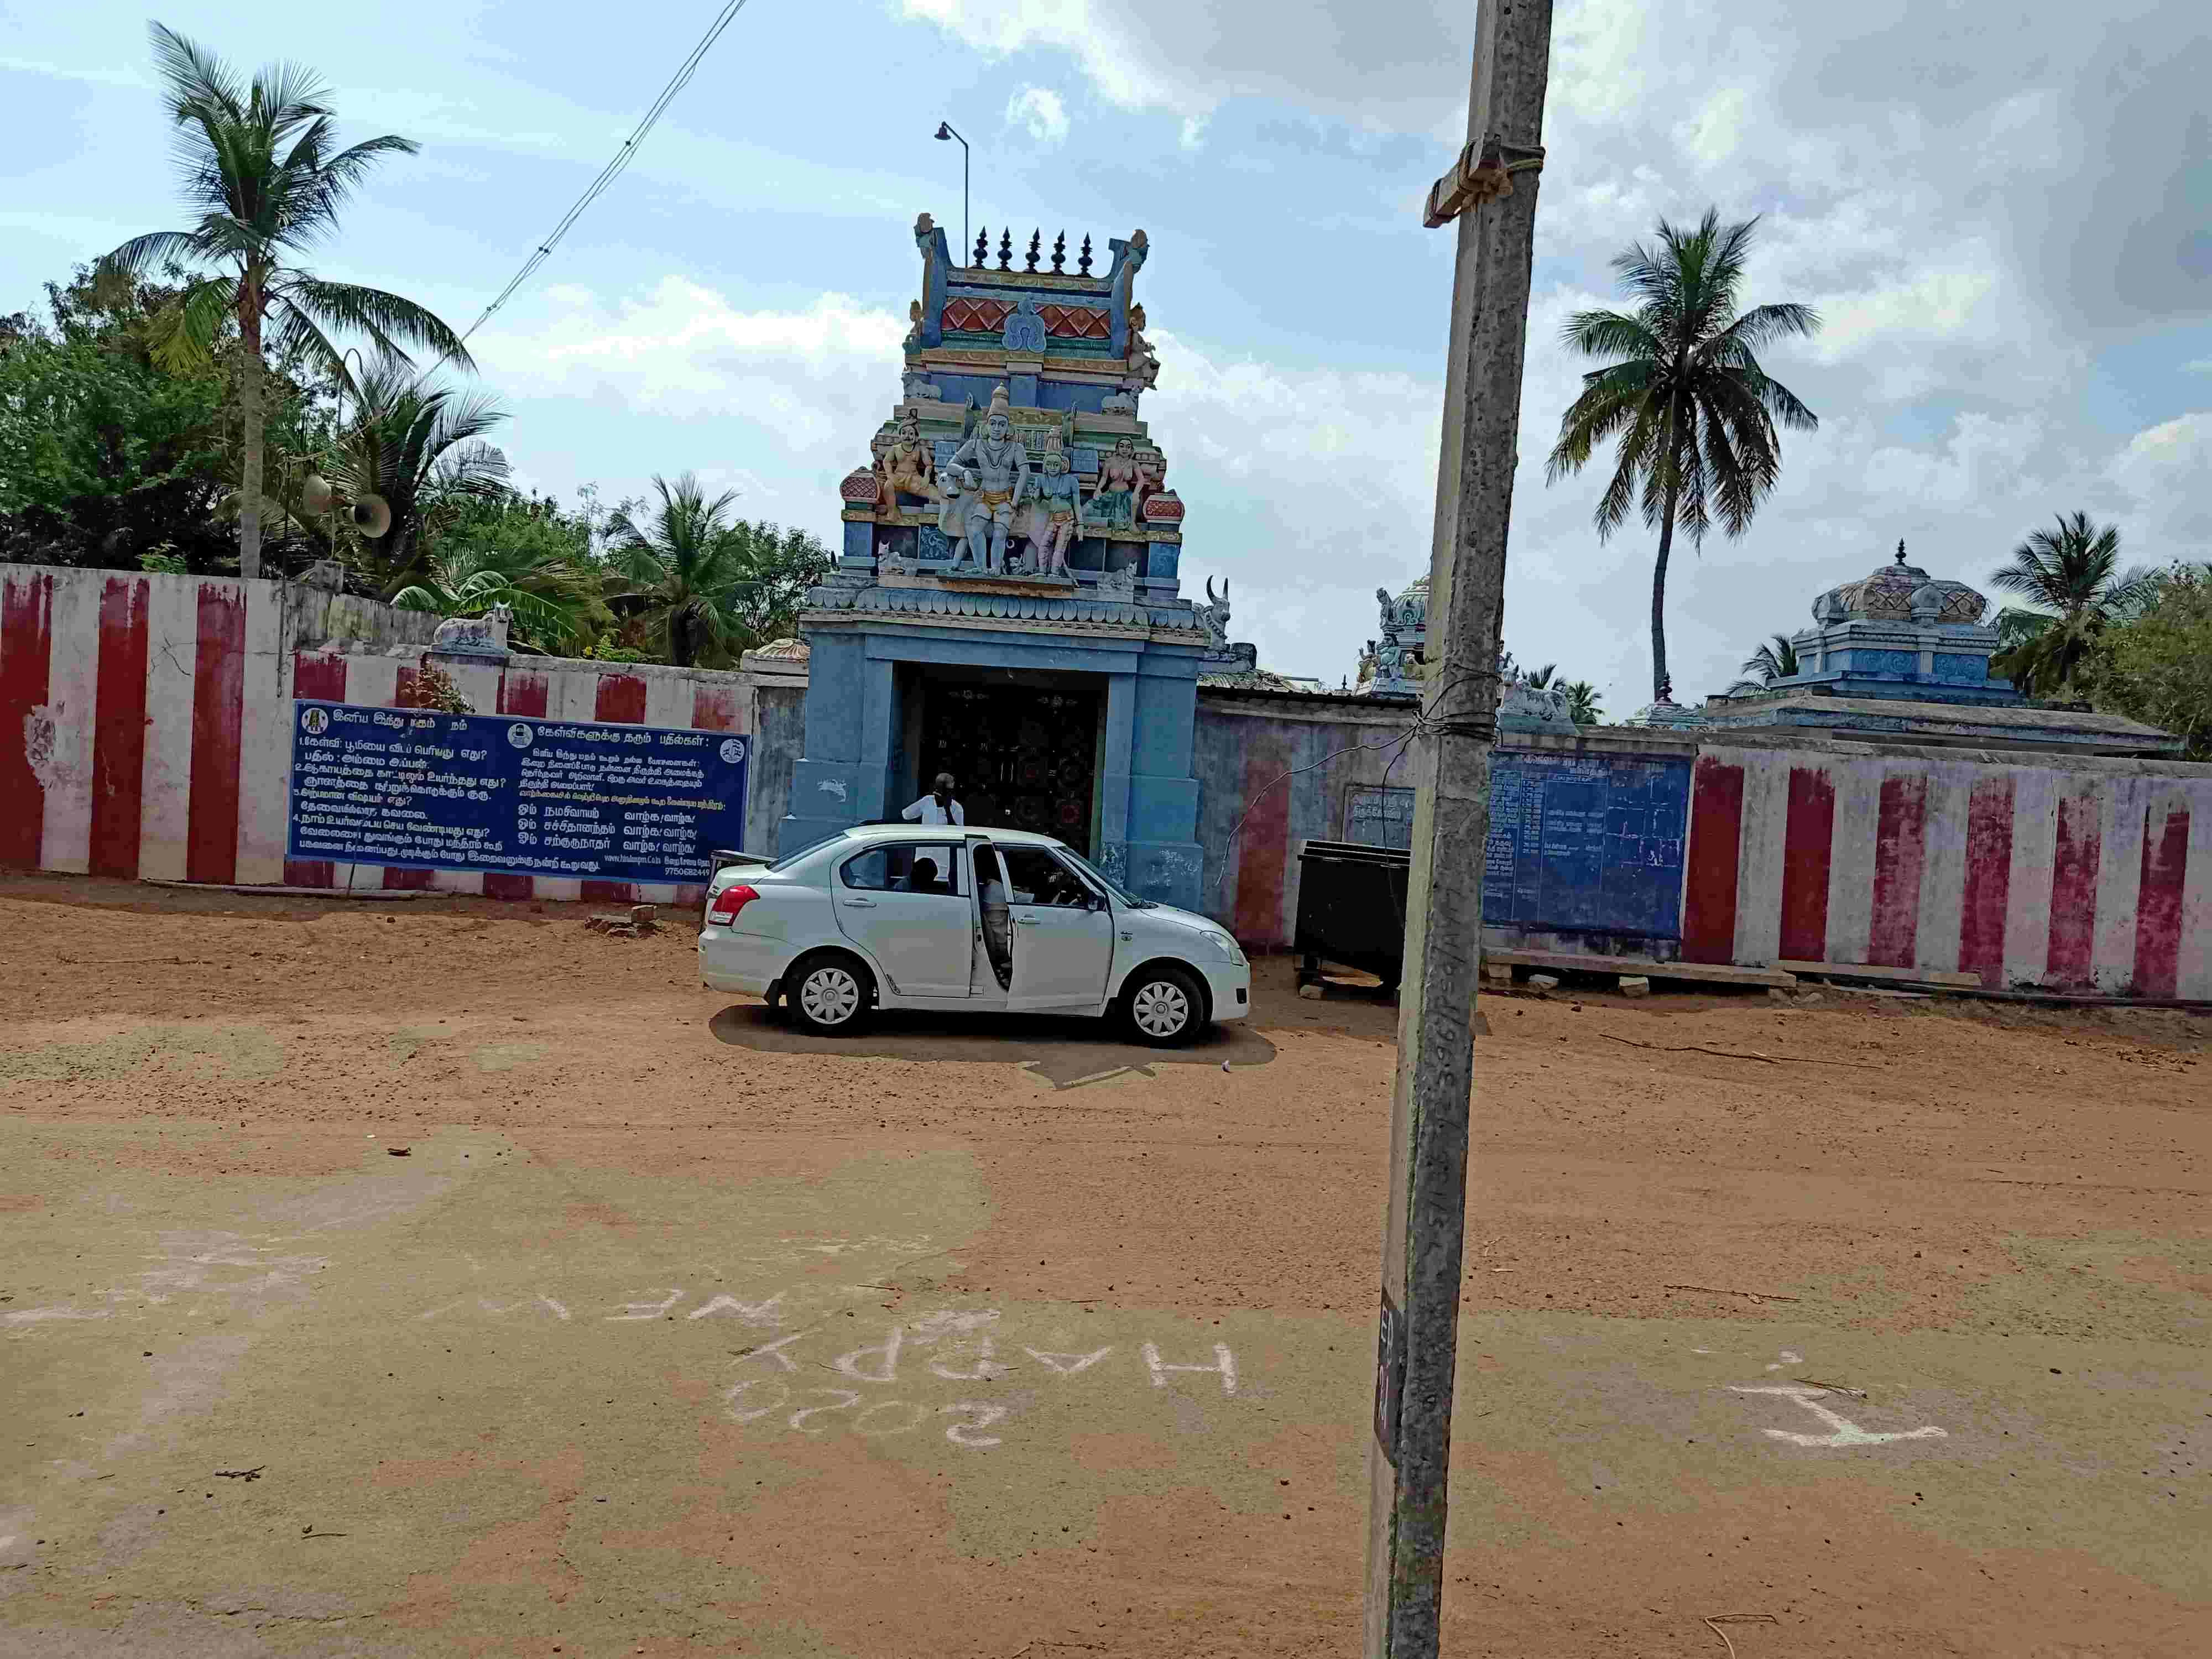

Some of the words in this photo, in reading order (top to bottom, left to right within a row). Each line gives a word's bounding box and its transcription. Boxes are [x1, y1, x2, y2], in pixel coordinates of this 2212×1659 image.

[333, 709, 368, 723] இனிய
[373, 712, 404, 728] இந்து
[538, 726, 620, 743] கேள்விகளுக்கு
[624, 732, 651, 744] தரும்
[345, 740, 385, 753] பூமியை
[461, 749, 487, 761] எது?
[427, 771, 477, 787] உயர்ந்தது
[480, 778, 506, 789] எது?
[544, 820, 615, 835] சச்சிதானந்தம்
